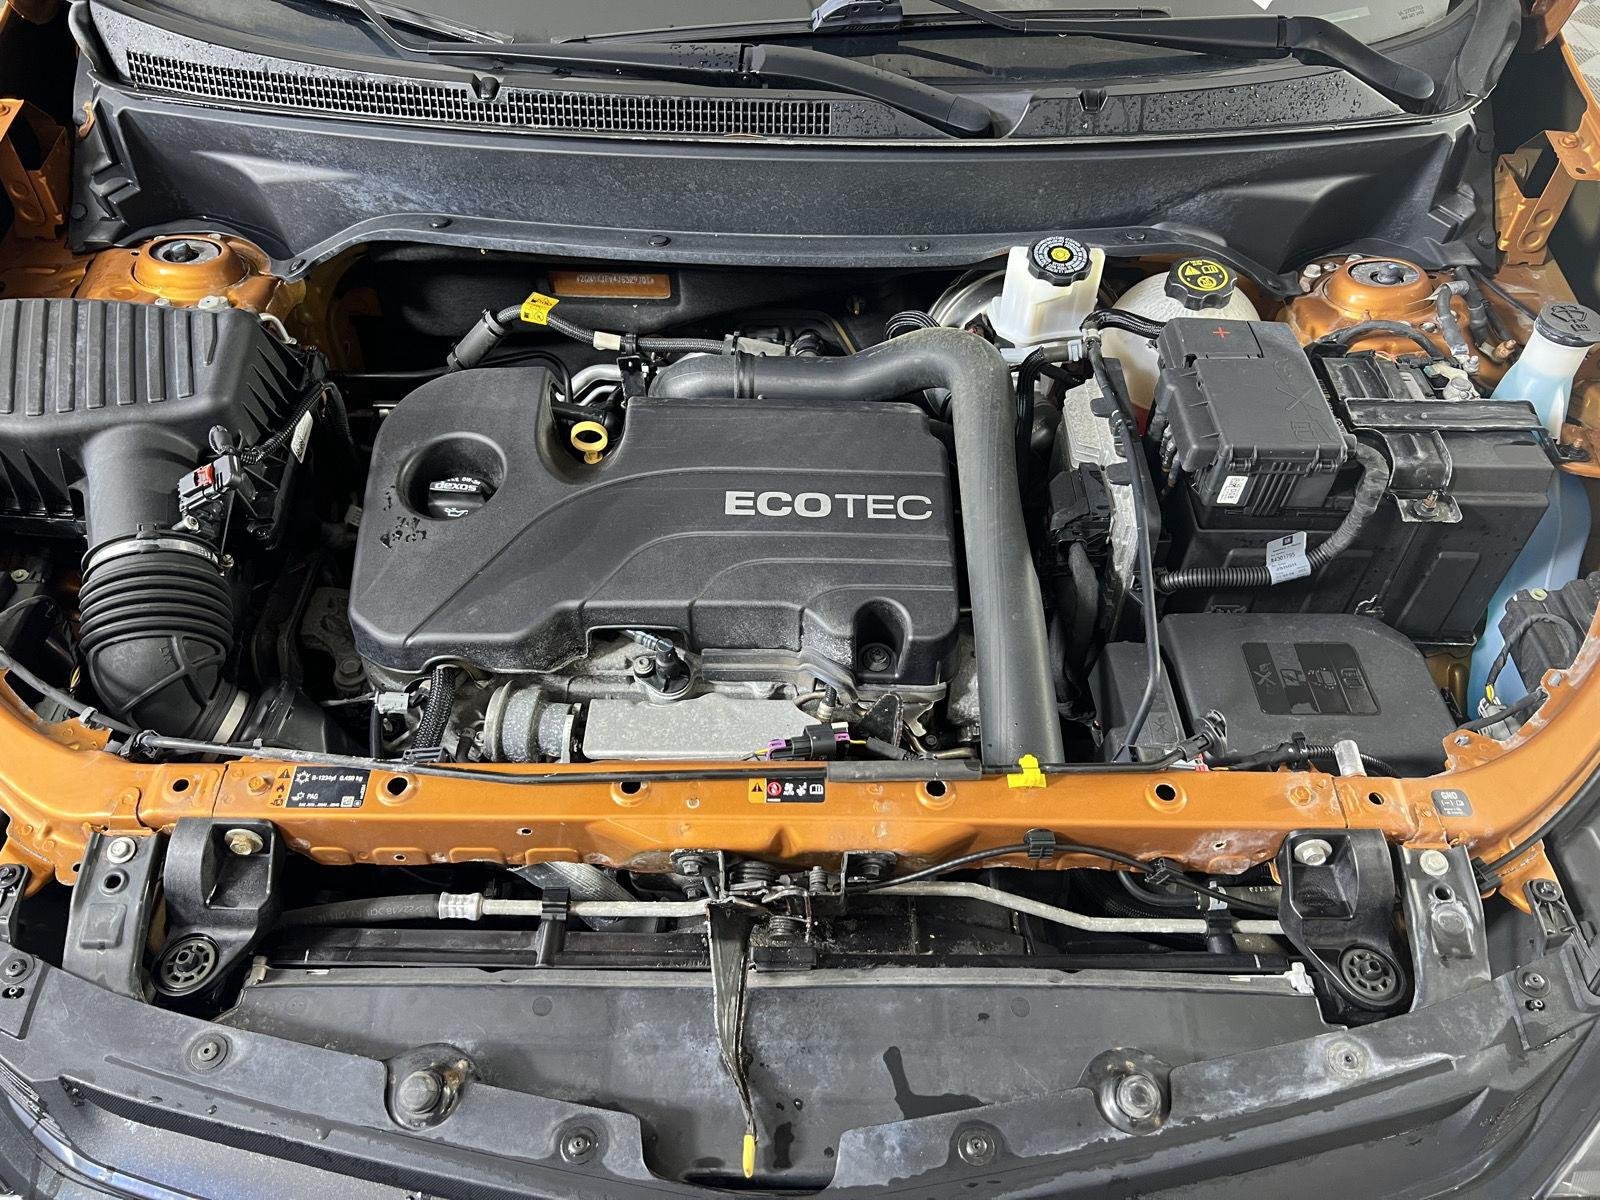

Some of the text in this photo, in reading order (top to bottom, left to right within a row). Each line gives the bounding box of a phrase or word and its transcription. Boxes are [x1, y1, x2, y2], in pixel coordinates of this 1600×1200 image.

[435, 481, 478, 491] dexos
[724, 490, 933, 520] ECOTEC
[1440, 791, 1458, 800] GND
